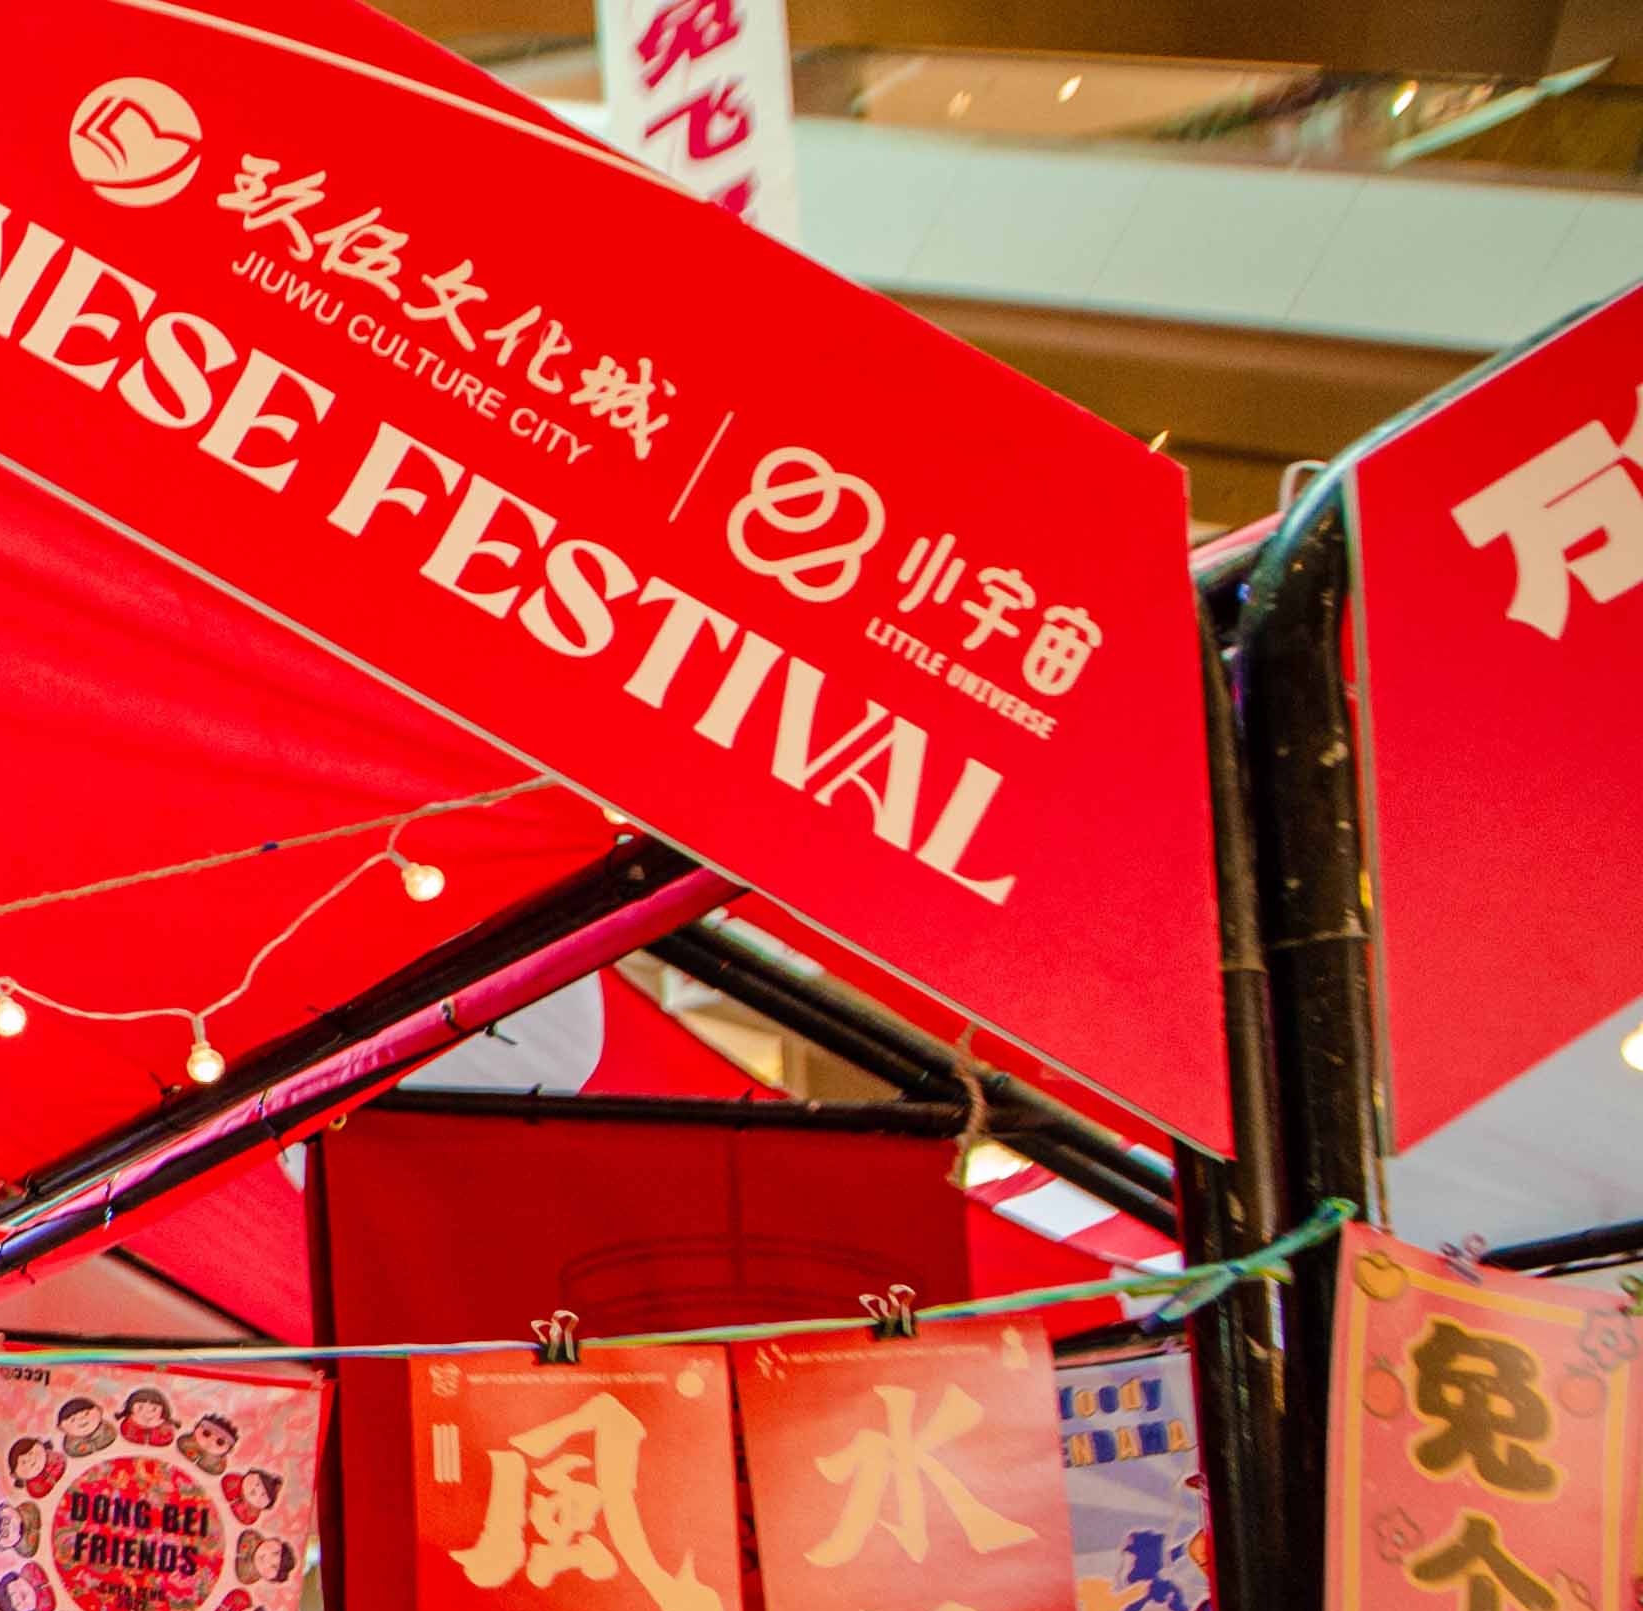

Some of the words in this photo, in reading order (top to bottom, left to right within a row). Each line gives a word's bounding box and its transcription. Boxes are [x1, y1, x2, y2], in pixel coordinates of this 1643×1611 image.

[217, 153, 675, 461] 玖伍文化城
[231, 248, 345, 327] JIUWU
[347, 312, 507, 419] CULTURE
[510, 405, 592, 466] CITY
[1451, 385, 1643, 640] 万
[327, 421, 1017, 906] FESTIVAL
[866, 616, 946, 675] LITTLE
[947, 666, 1057, 740] UNIVERSE
[897, 532, 1103, 697] 小宇宙
[70, 1491, 152, 1530] DONG
[161, 1503, 209, 1538] BEI
[72, 1532, 199, 1576] FRIENDS
